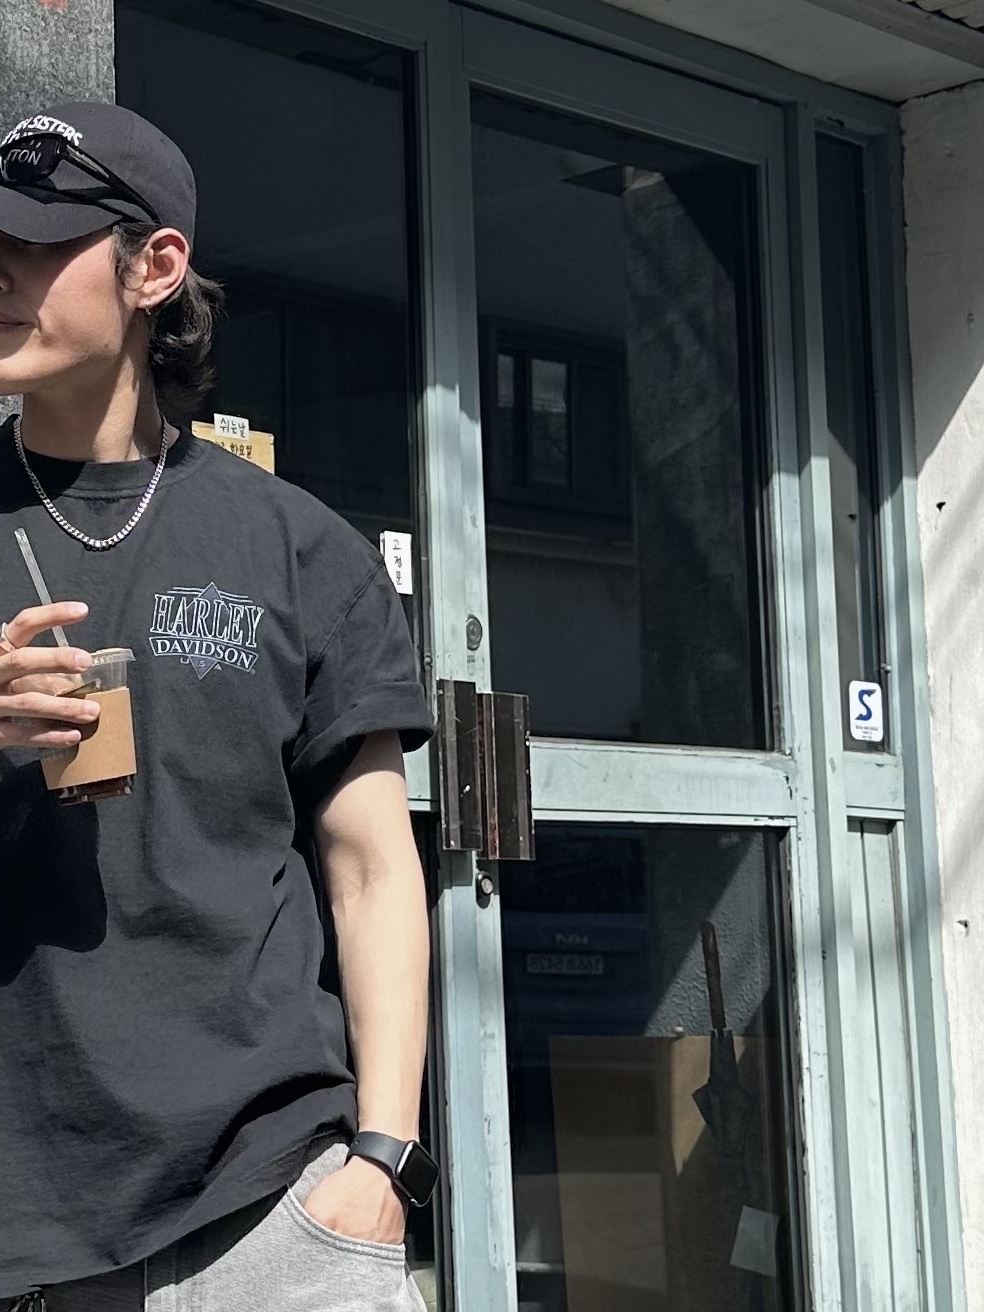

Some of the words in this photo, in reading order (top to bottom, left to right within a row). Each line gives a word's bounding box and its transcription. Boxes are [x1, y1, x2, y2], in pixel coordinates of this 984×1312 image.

[28, 115, 83, 146] SISTERS
[220, 418, 245, 438] 쉬는날
[150, 594, 264, 648] HARLEY
[156, 640, 253, 669] DAVIDSON
